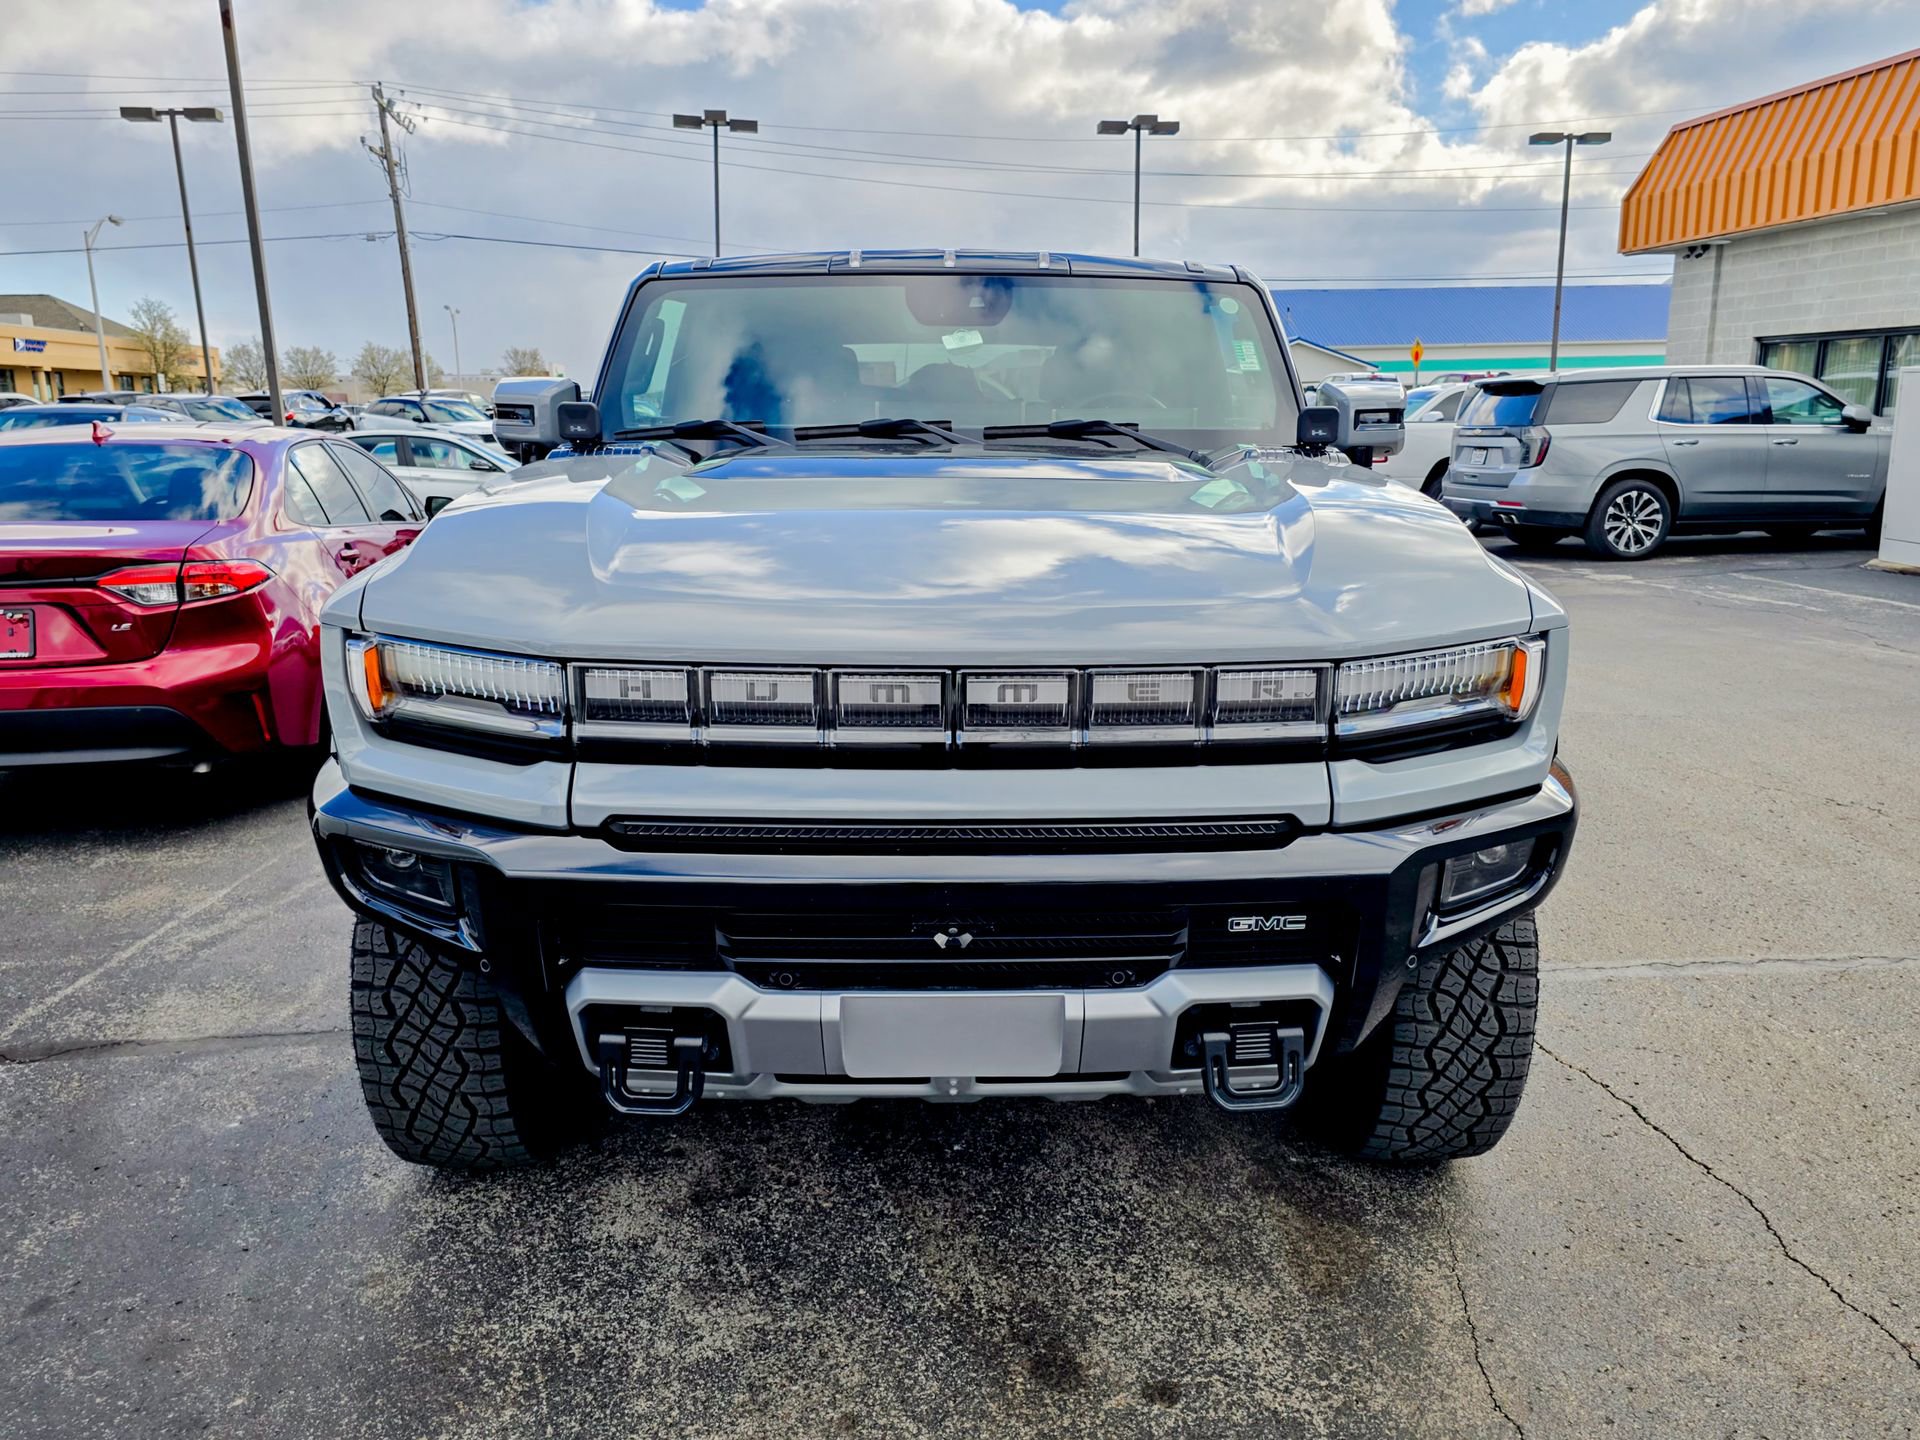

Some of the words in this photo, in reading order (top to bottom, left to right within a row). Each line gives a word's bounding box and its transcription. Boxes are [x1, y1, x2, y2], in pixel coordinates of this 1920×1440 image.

[111, 623, 132, 631] LE
[620, 679, 1283, 703] HUMMER
[1228, 915, 1307, 932] GMC
